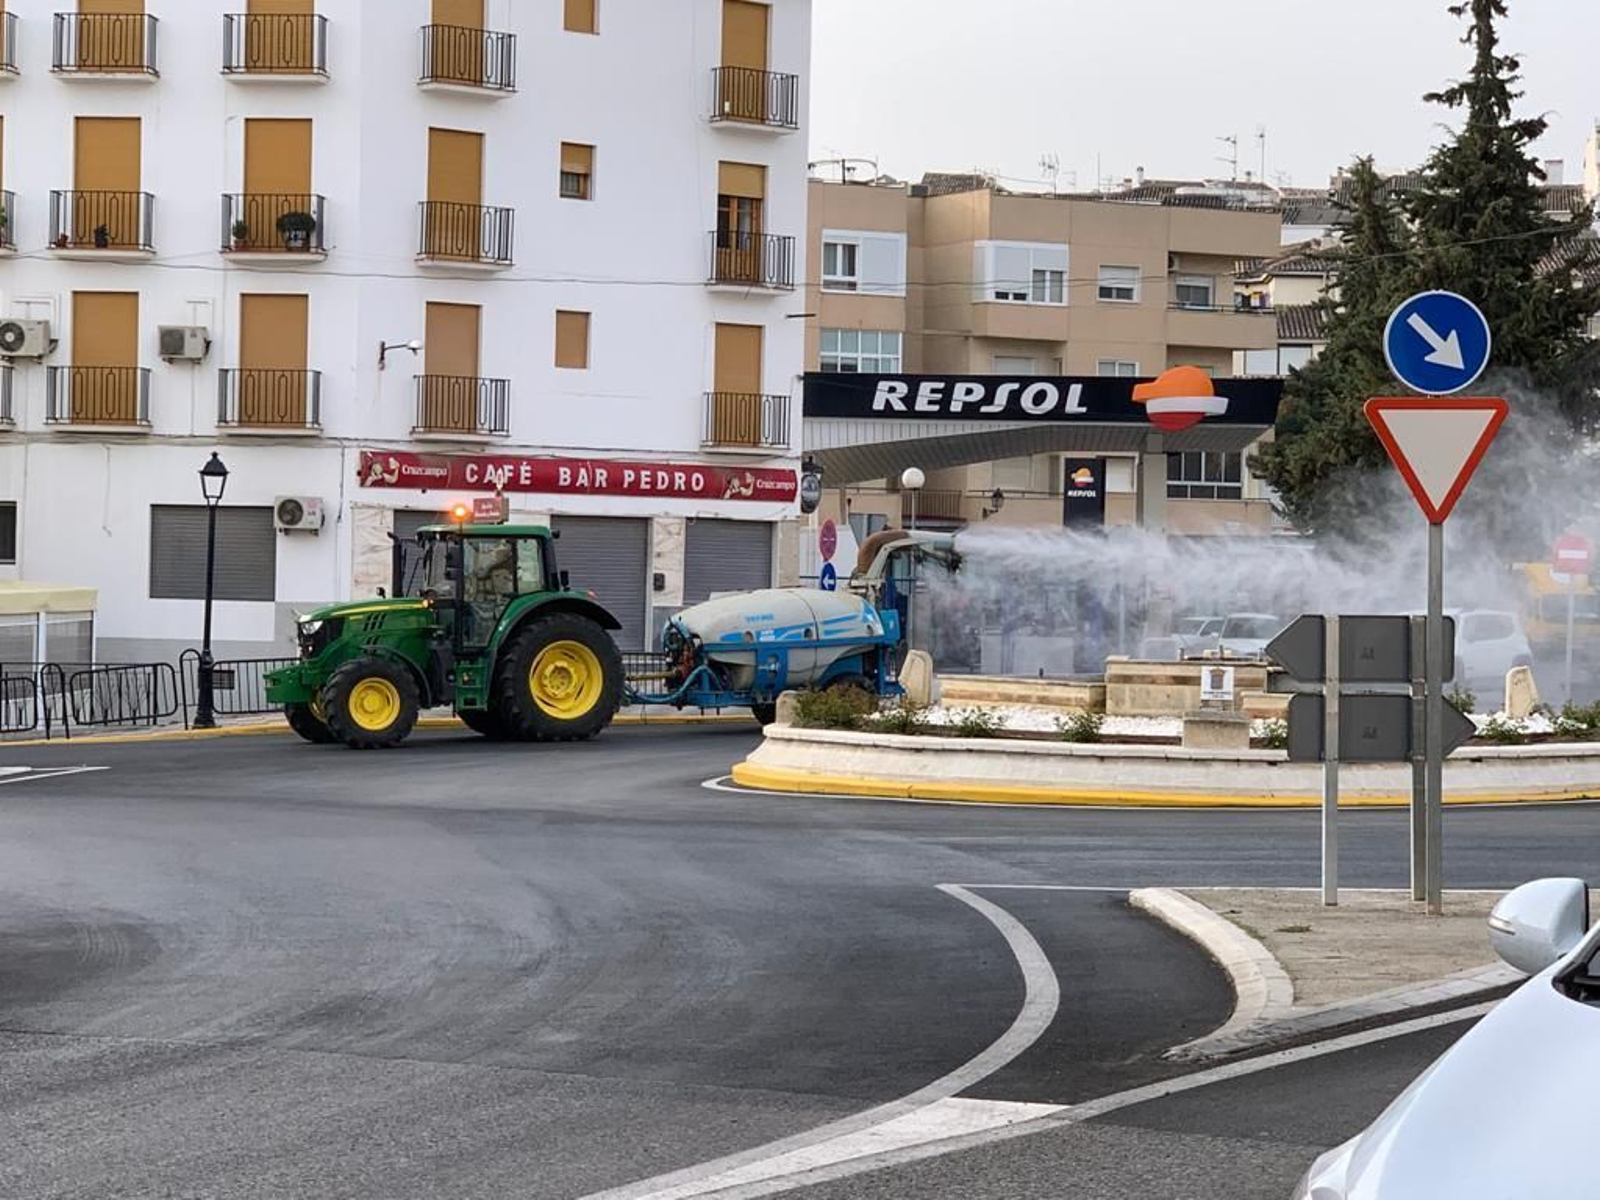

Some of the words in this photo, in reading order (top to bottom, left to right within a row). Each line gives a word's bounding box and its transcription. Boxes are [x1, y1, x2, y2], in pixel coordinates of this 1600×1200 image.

[872, 380, 1088, 414] REPSOL
[402, 464, 448, 477] Cruzcampo
[465, 461, 532, 485] CAFÉ
[558, 467, 608, 488] BAR
[623, 469, 704, 491] PEDRO
[756, 478, 795, 491] Cruzcampo
